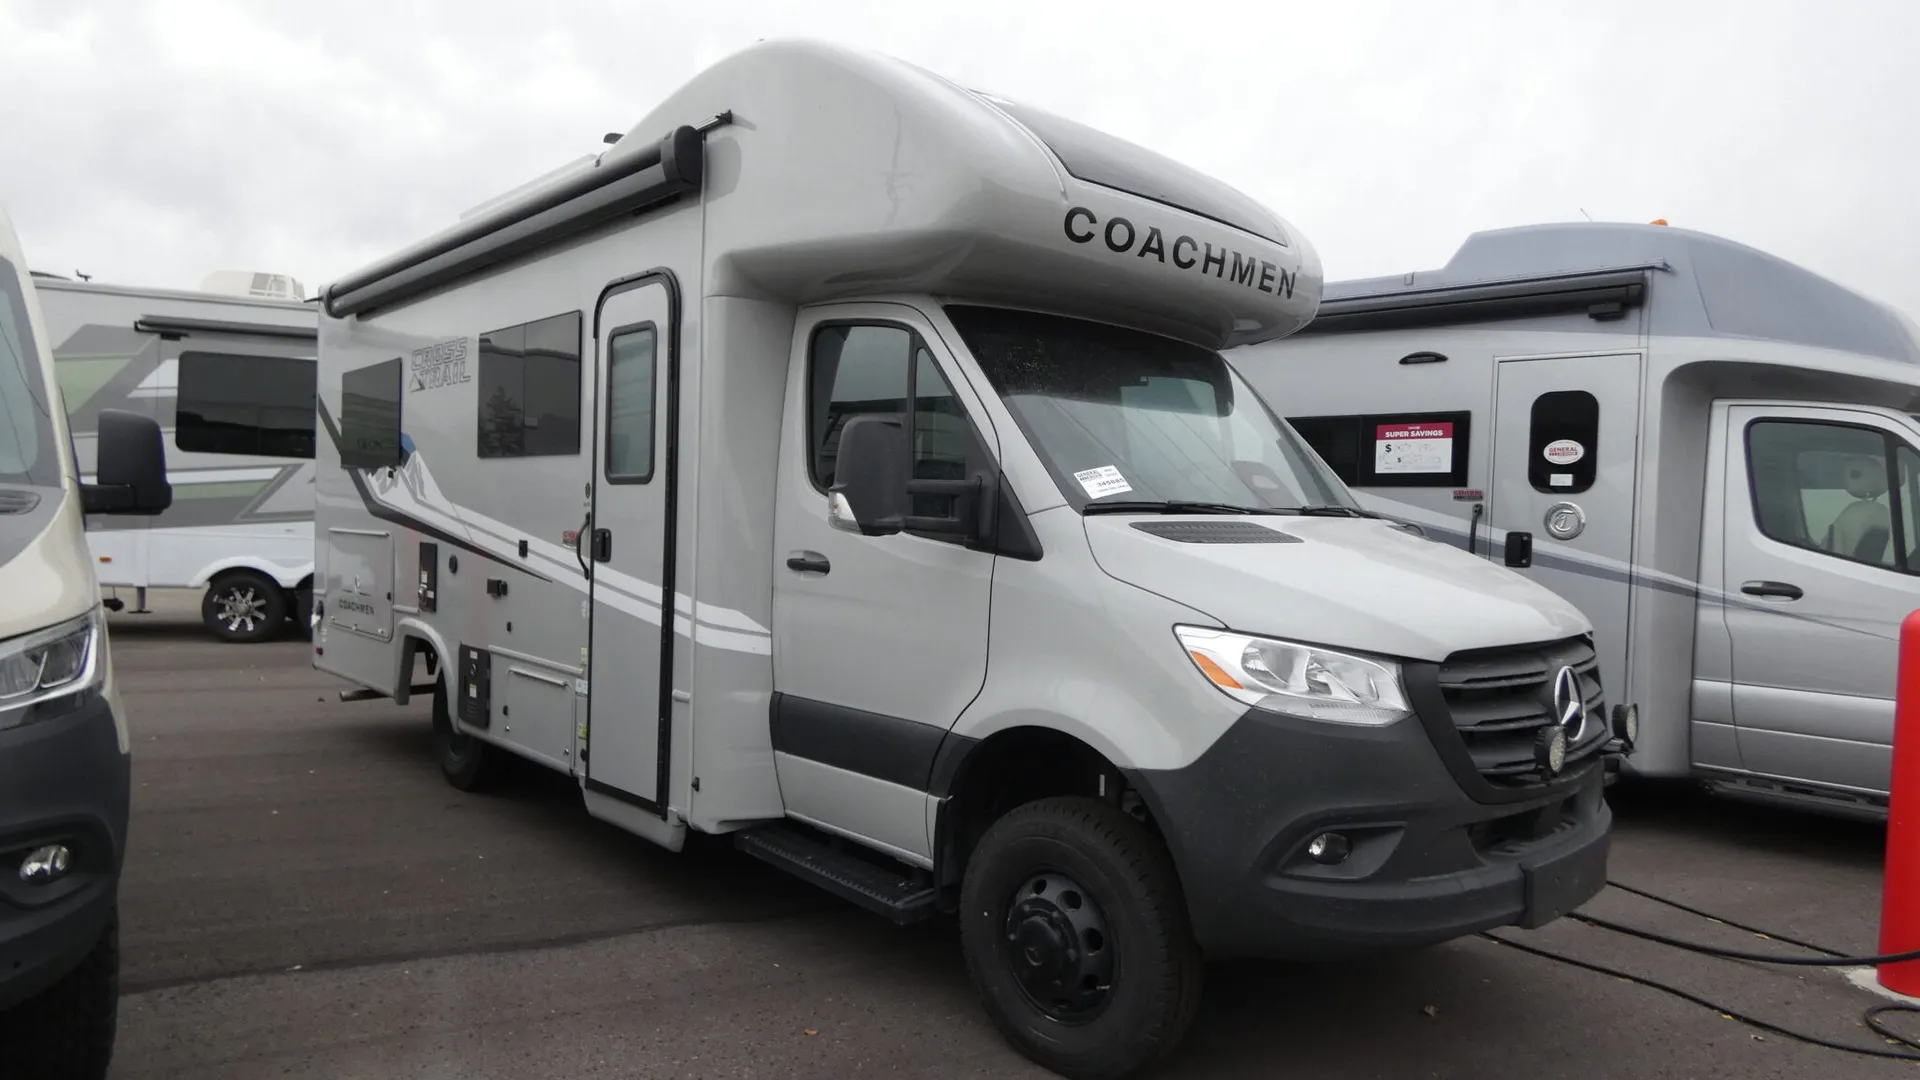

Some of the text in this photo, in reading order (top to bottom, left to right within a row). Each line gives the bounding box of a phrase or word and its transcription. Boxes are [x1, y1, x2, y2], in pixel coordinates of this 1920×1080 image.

[1064, 206, 1296, 300] COACHMEN
[411, 336, 468, 371] CROSS
[419, 361, 471, 390] TRAIL
[339, 599, 375, 616] COACHMEN
